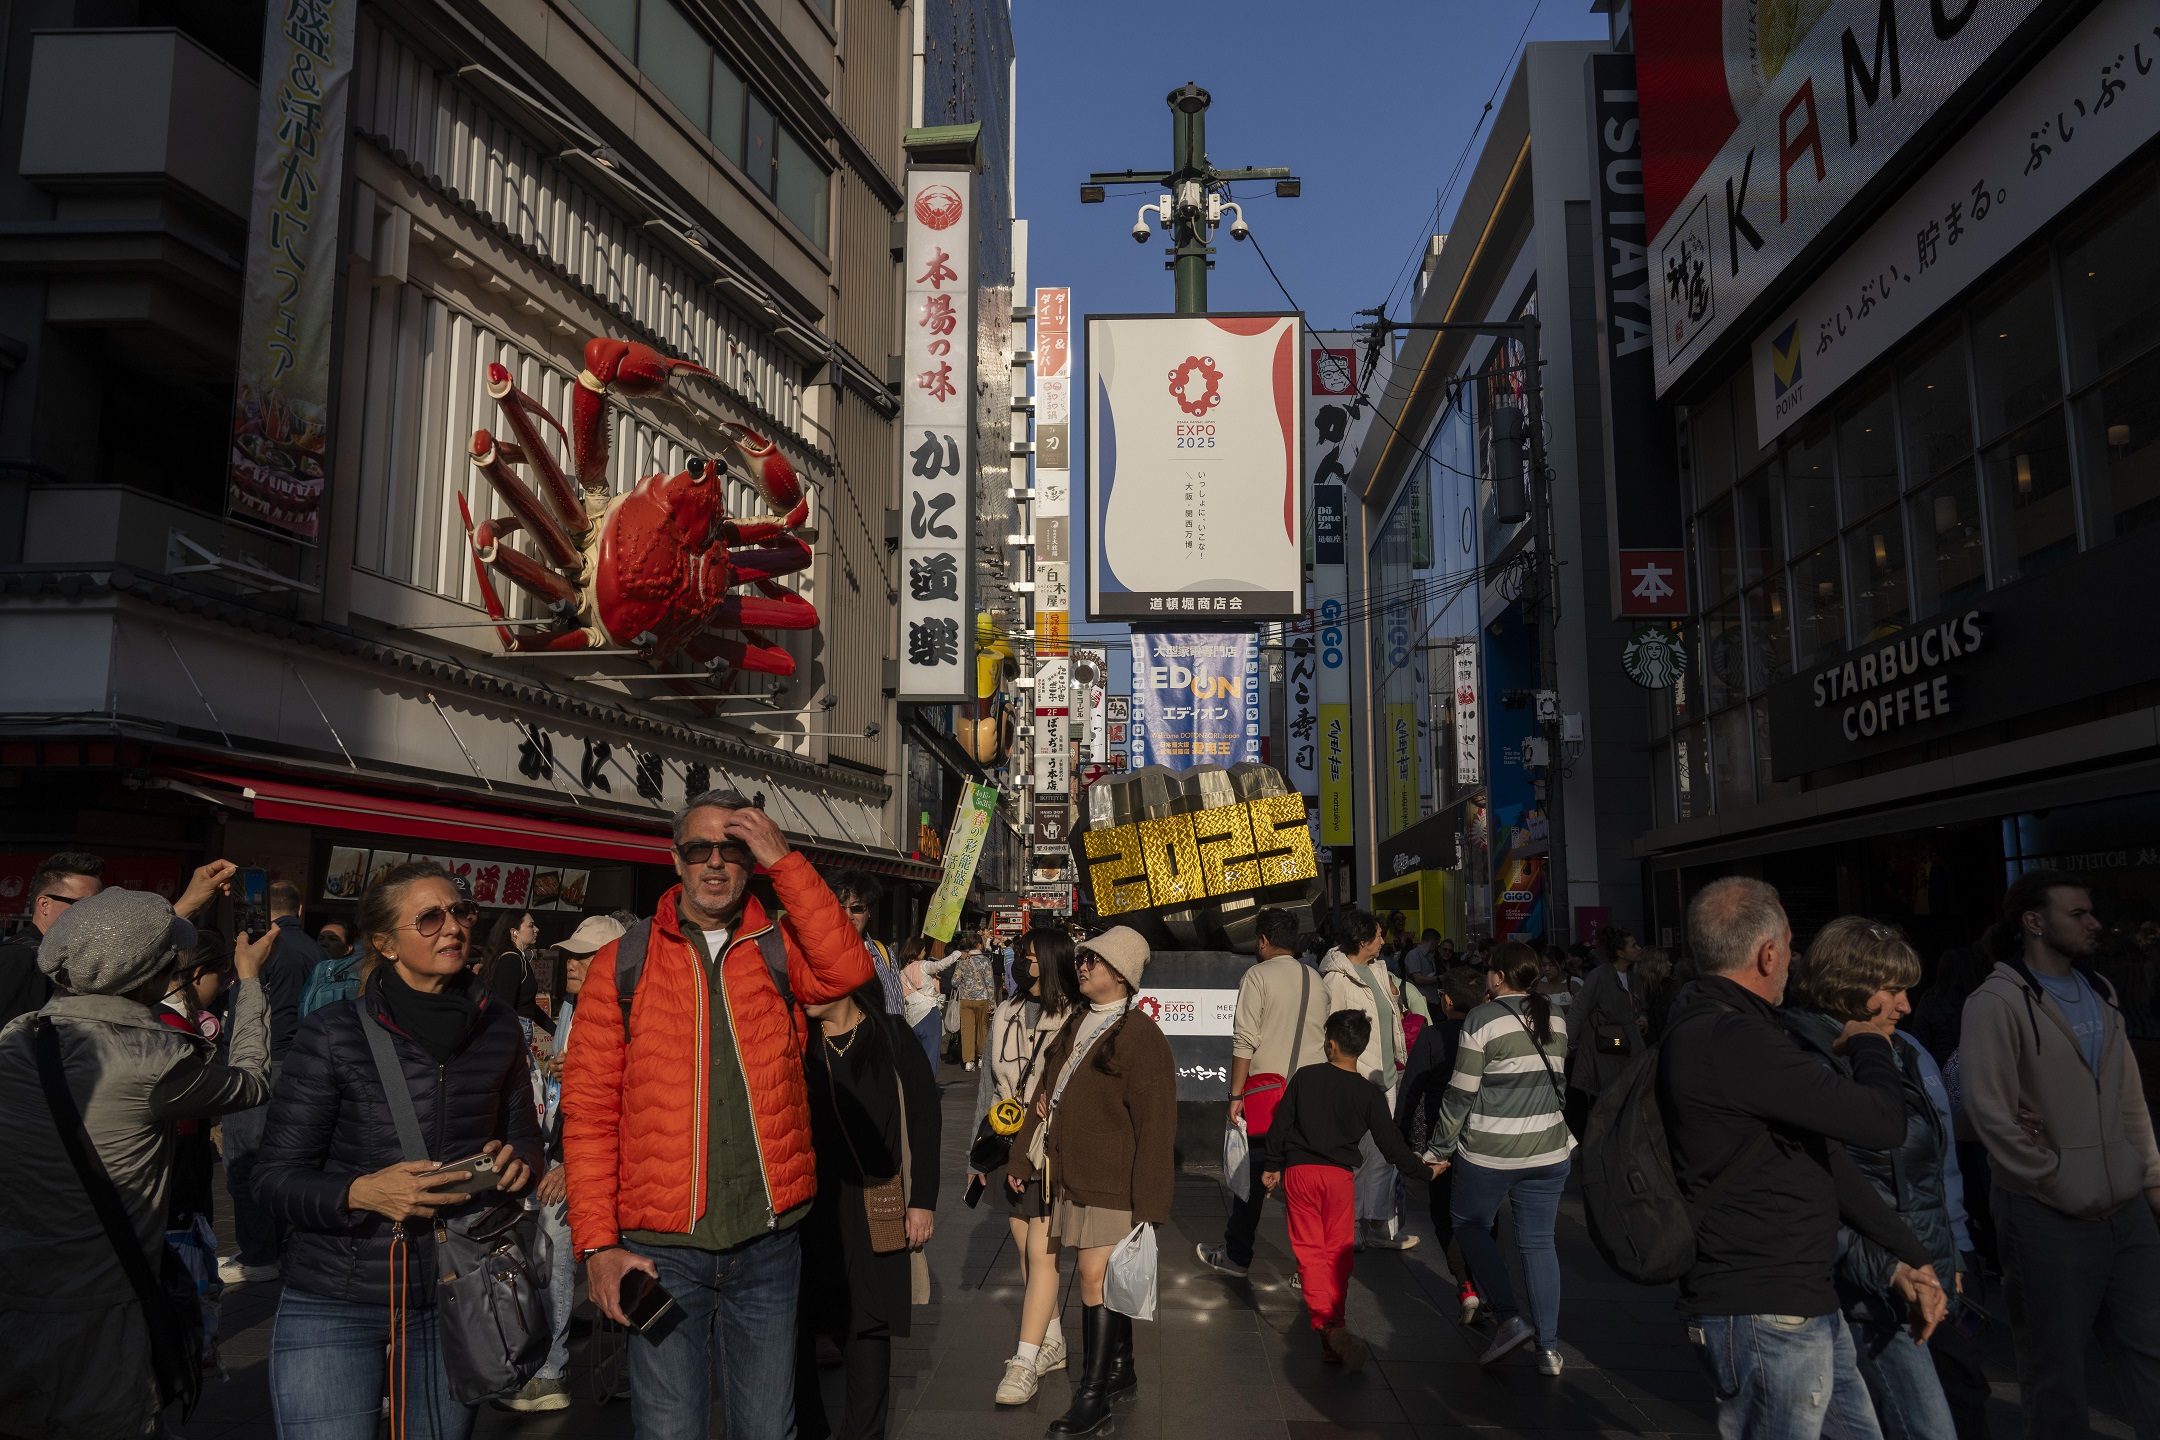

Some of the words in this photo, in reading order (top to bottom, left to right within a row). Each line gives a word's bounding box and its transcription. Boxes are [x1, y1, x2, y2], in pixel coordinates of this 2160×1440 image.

[916, 247, 958, 402] 本場の味
[1776, 385, 1804, 420] POINT
[1177, 425, 1216, 436] EXPO
[1177, 437, 1215, 449] 2025
[1046, 568, 1066, 608] 白木屋
[1631, 562, 1675, 603] 本
[1150, 597, 1243, 610] 道頓堀商店会
[1321, 599, 1343, 669] GiGO
[1153, 646, 1238, 658] 大型家電専門店
[1813, 610, 1983, 708] STARBUCKS
[1150, 665, 1241, 699] EDION
[1047, 708, 1058, 716] 2F
[1162, 707, 1228, 720] エディオン
[1842, 674, 1950, 742] COFFEE
[1083, 792, 1317, 917] 2025
[1503, 892, 1532, 901] GiGO
[1164, 1004, 1195, 1013] EXPO
[1164, 1013, 1195, 1021] 2025
